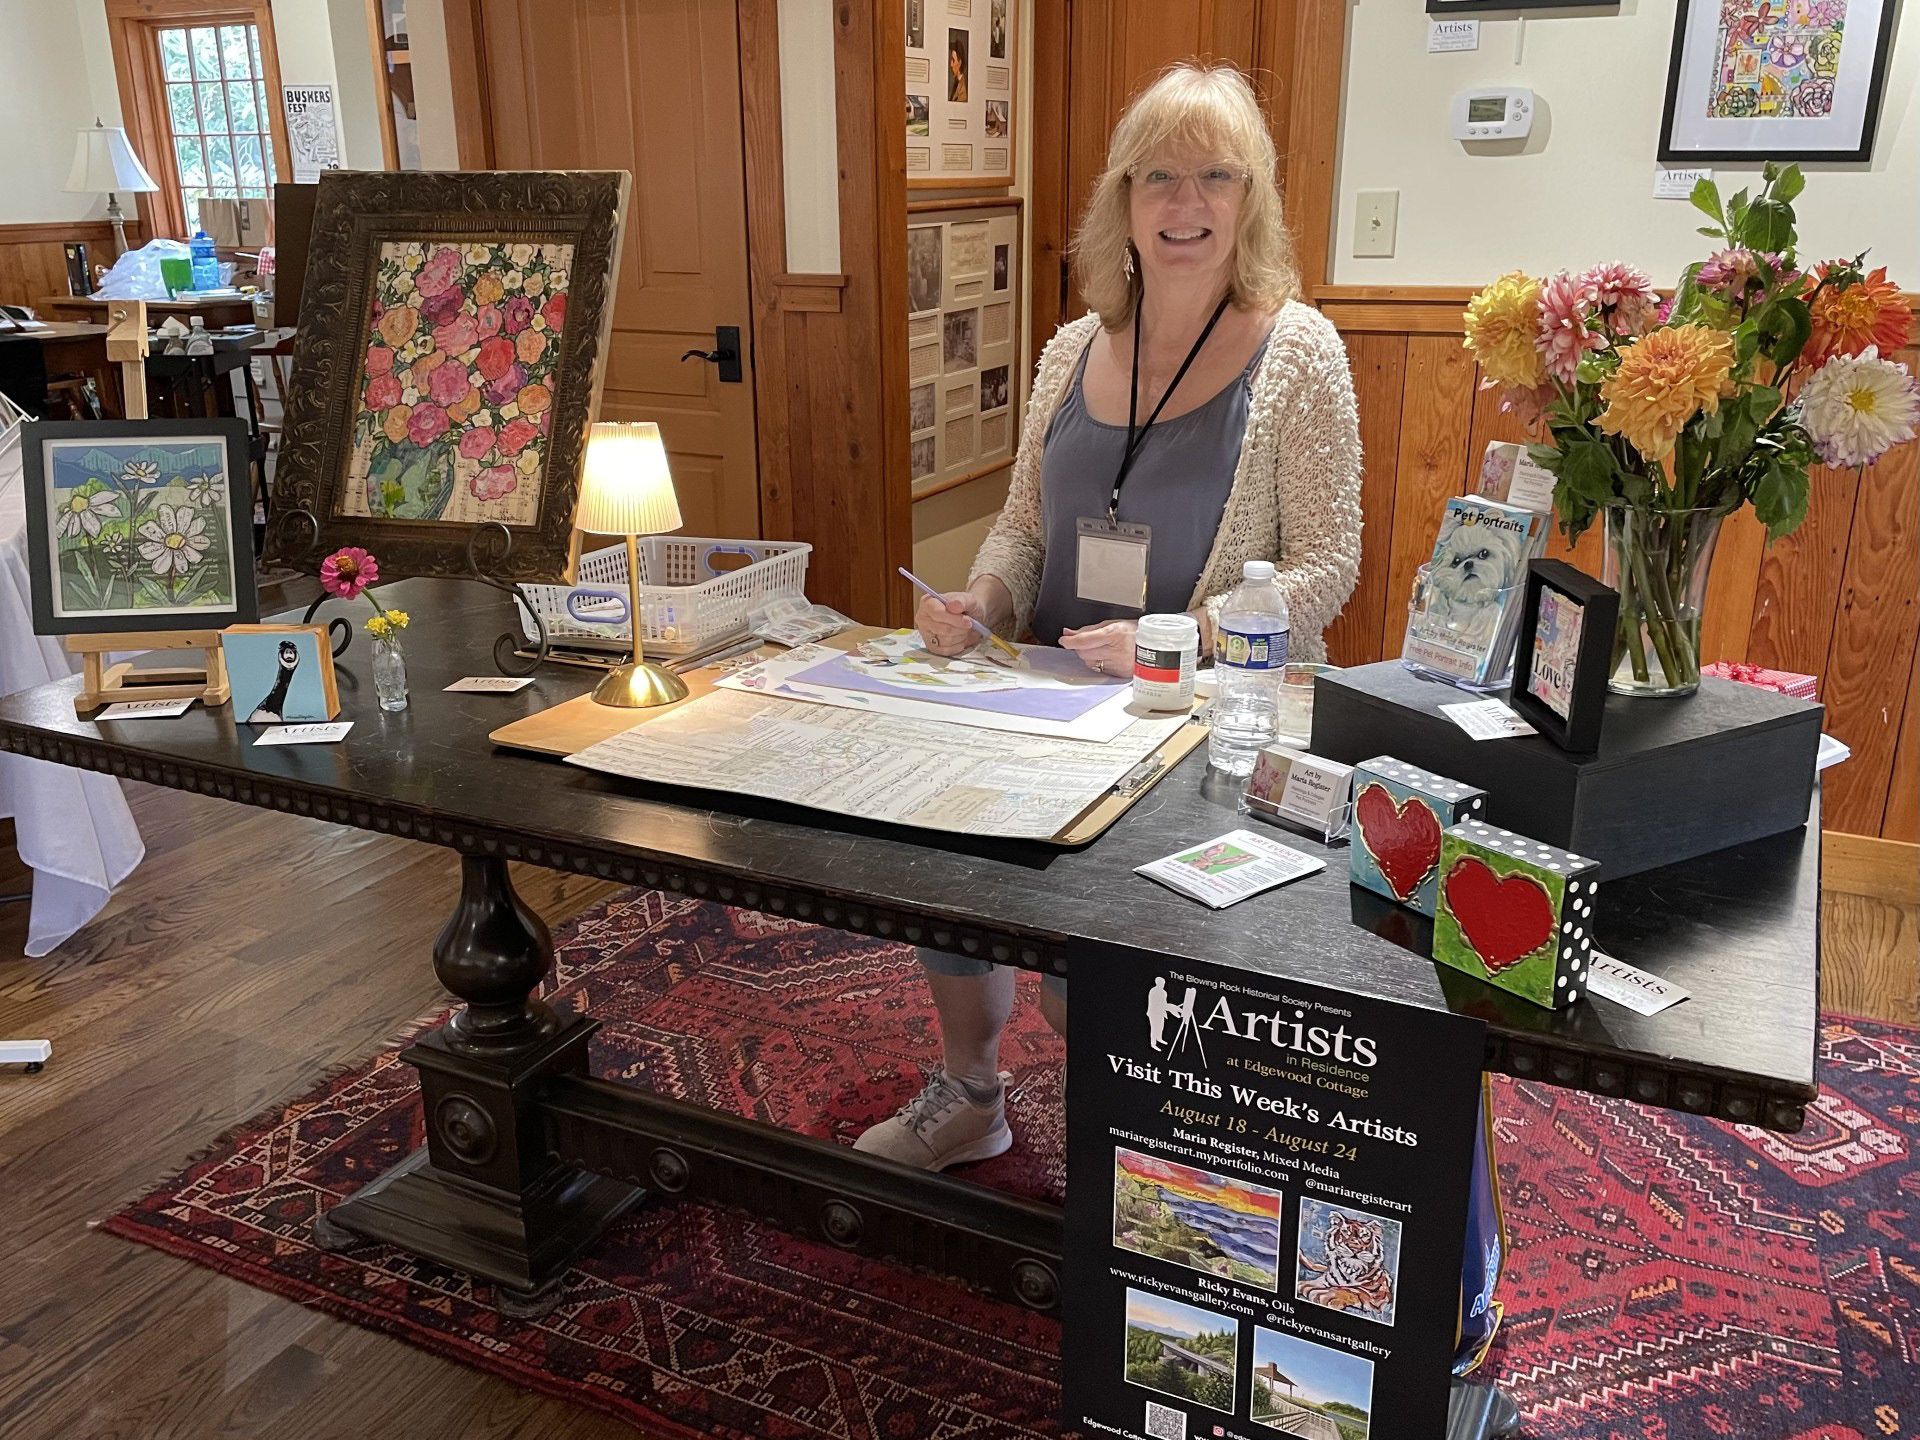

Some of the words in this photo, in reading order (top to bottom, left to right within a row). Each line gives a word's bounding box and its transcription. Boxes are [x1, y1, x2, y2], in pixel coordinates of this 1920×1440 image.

[1434, 22, 1473, 33] Artists
[286, 90, 331, 103] BUSKERS
[288, 103, 307, 113] FEST
[1453, 507, 1474, 522] Pet
[1476, 513, 1525, 533] Portraits
[1409, 643, 1422, 655] Free
[1423, 648, 1434, 659] Pet
[1434, 651, 1457, 666] Portrait
[1459, 660, 1473, 671] Info
[1534, 653, 1561, 690] Love
[1304, 769, 1315, 777] Art
[1315, 771, 1322, 780] by
[1249, 837, 1269, 846] ART
[1268, 844, 1305, 861] EVENTS
[1169, 970, 1185, 981] The
[1186, 974, 1218, 990] Blowing
[1219, 981, 1241, 994] Rock
[1242, 986, 1281, 1002] Historical
[1281, 995, 1313, 1011] Society
[1314, 1002, 1352, 1018] Presents
[1198, 995, 1378, 1067] Artists
[1226, 1056, 1239, 1068] at
[1244, 1059, 1312, 1085] Edgewood
[1316, 1077, 1369, 1099] Cottage
[1286, 1053, 1298, 1066] in
[1301, 1057, 1370, 1082] Residence
[1107, 1053, 1162, 1084] Visit
[1168, 1069, 1222, 1099] This
[1230, 1084, 1320, 1123] Week's
[1327, 1110, 1418, 1147] Artists
[1159, 1099, 1221, 1125] August
[1226, 1116, 1247, 1134] 18
[1263, 1126, 1329, 1154] August
[1333, 1143, 1357, 1162] 24
[1109, 1126, 1290, 1182] mariaregisterart.myportfolio.com
[1305, 1178, 1413, 1214] @mariaregisterart
[1172, 1127, 1208, 1146] Maria
[1210, 1136, 1260, 1160] Register,
[1263, 1150, 1300, 1170] Mixed
[1303, 1160, 1340, 1180] Media
[1109, 1267, 1255, 1317] www.rickyevansgallery.com
[1266, 1313, 1392, 1360] @rickyevansartgallery
[1197, 1277, 1230, 1297] Ricky
[1232, 1287, 1270, 1308] Evans,
[1271, 1299, 1296, 1315] Oils
[1083, 1416, 1122, 1436] Edgewood
